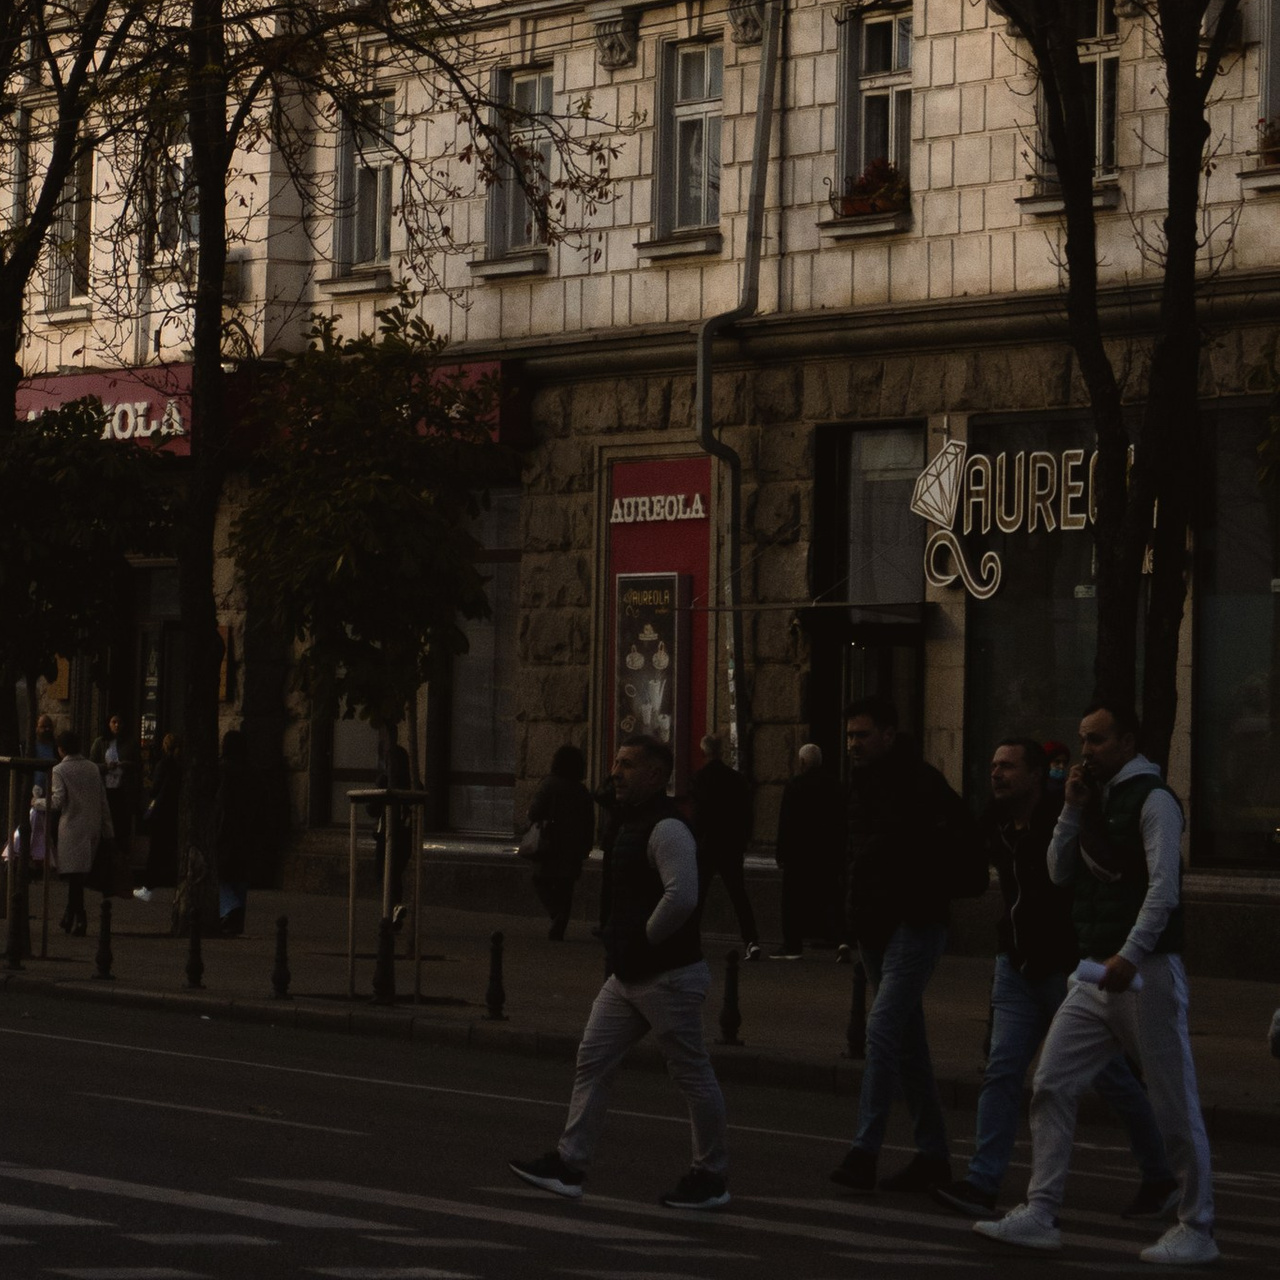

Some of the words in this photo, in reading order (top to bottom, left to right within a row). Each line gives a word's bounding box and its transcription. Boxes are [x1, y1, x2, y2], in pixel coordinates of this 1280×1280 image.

[609, 493, 705, 523] AUREOLA
[963, 449, 1135, 537] AURE
[631, 589, 670, 606] AUREOLA
